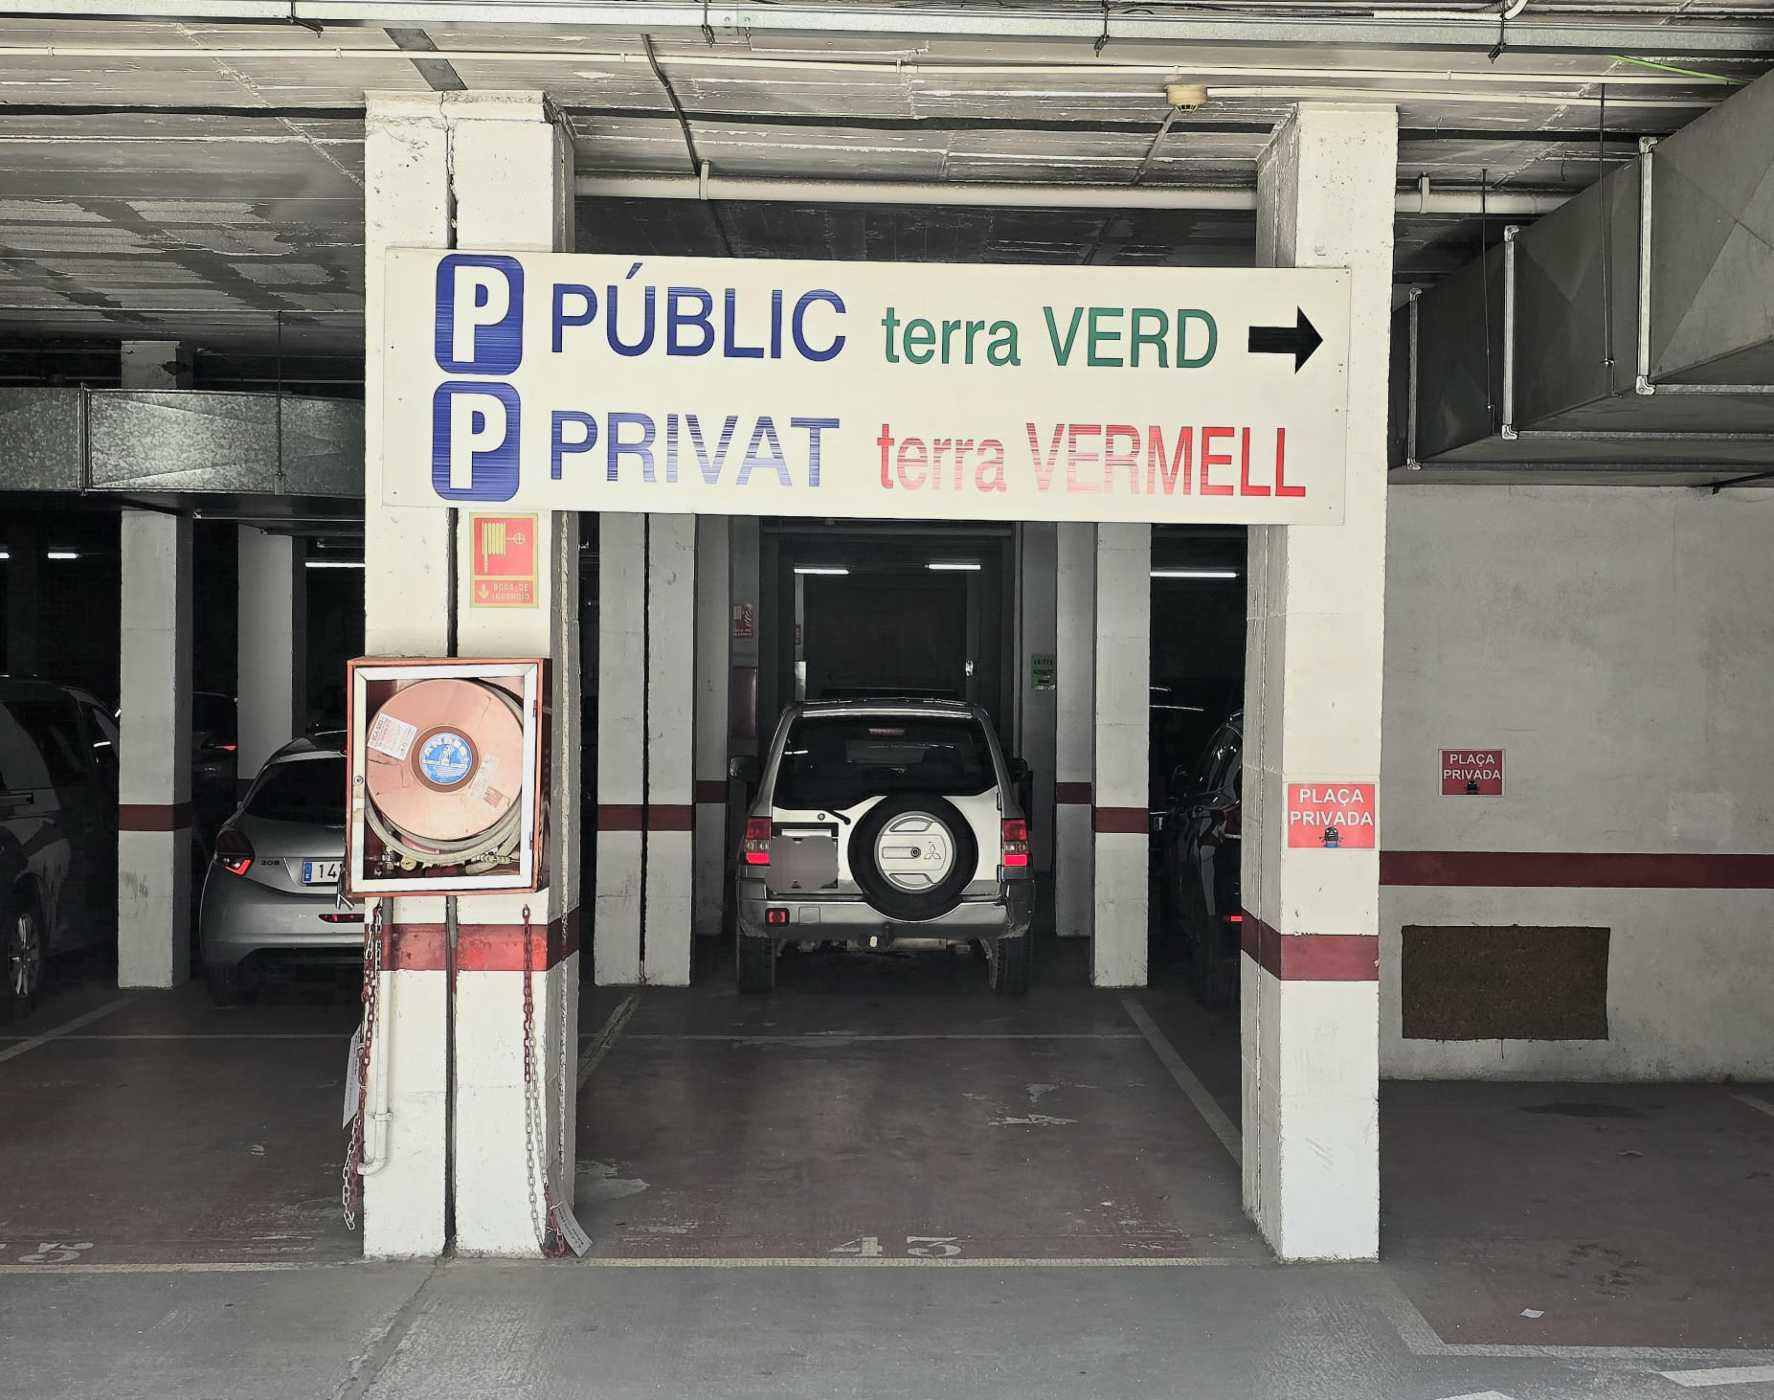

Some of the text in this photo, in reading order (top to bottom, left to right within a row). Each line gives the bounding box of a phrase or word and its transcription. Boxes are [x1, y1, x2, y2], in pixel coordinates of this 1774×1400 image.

[451, 263, 1218, 369] P PÚBLIC terra VERD
[449, 392, 1307, 497] P PRIVAT terra VERMELL
[1450, 753, 1495, 767] PLAÇA
[1443, 769, 1501, 780] PRIVADA
[1299, 788, 1364, 806] PLAÇA
[1290, 811, 1374, 826] PRIVADA
[319, 863, 342, 879] 14
